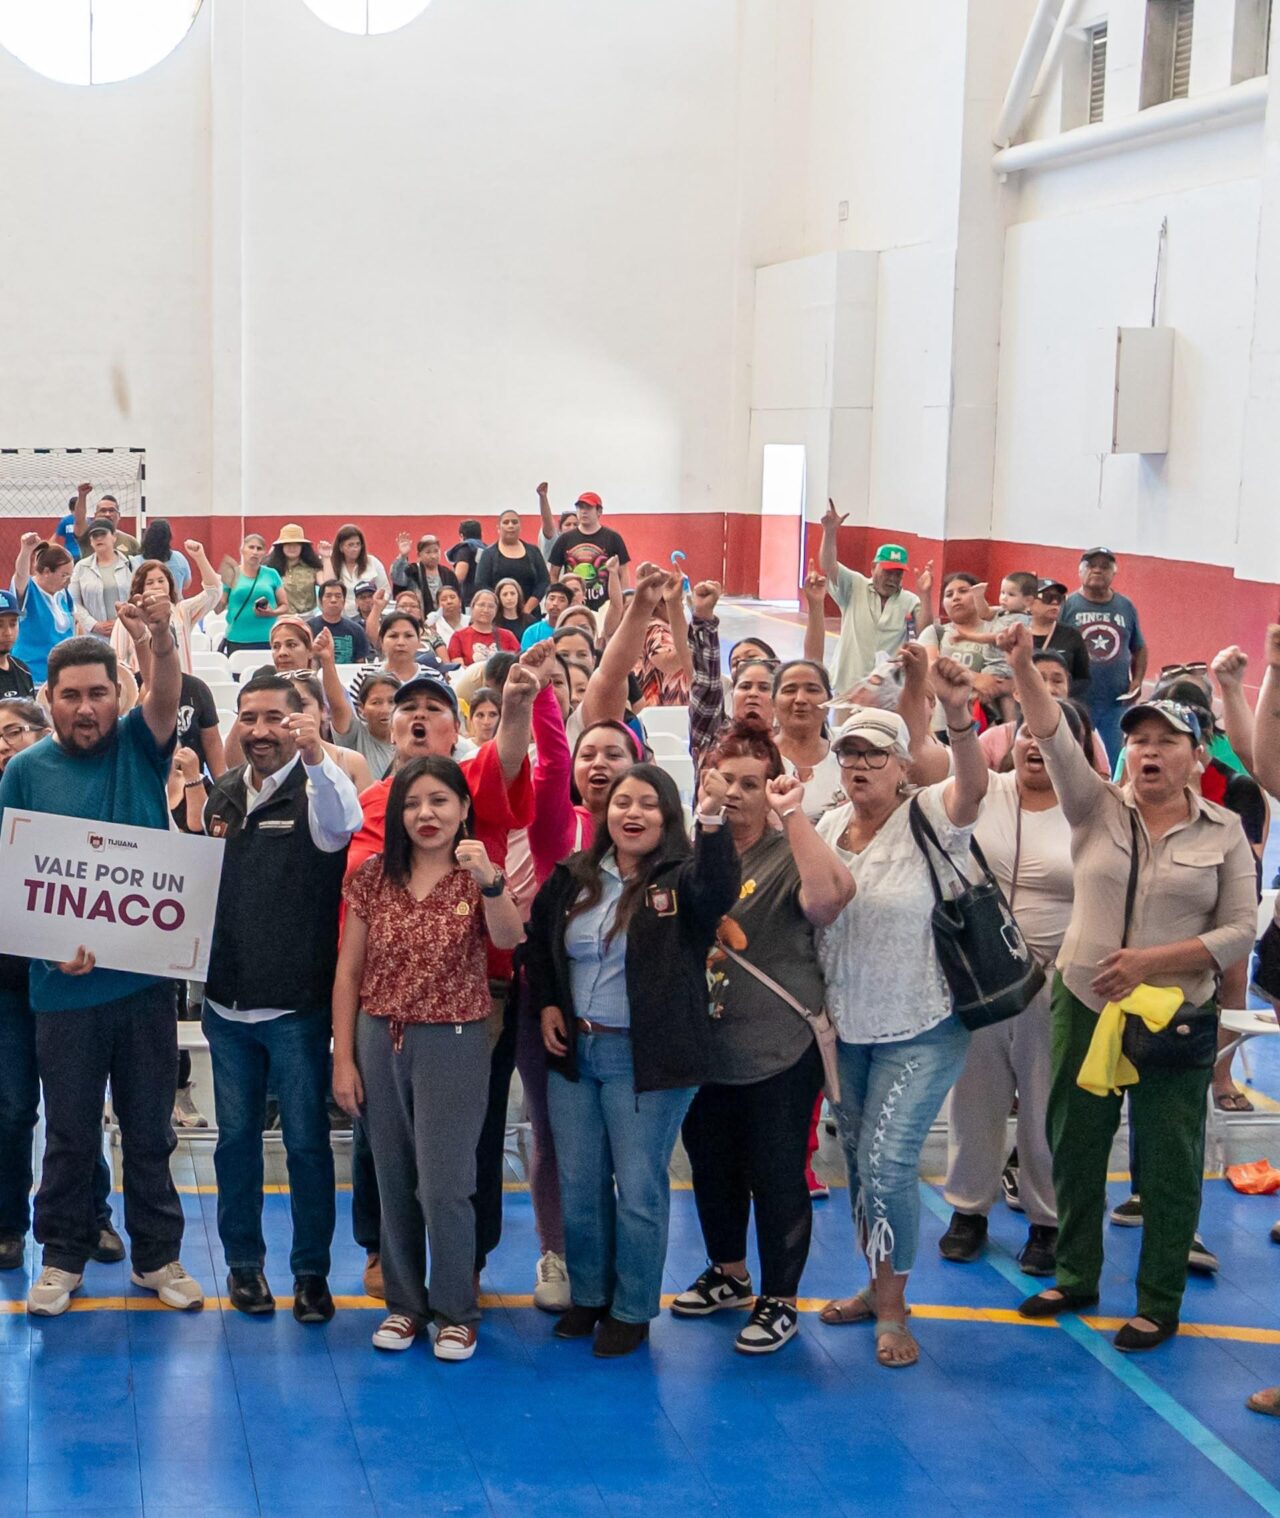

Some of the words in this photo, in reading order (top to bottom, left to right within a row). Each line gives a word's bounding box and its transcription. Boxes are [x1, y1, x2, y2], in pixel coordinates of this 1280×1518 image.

[1075, 612, 1111, 627] SINCE
[107, 838, 138, 849] TIJUANA
[34, 854, 88, 880] VALE
[95, 863, 145, 888] POR
[152, 871, 185, 893] UN
[23, 879, 186, 932] TINACO
